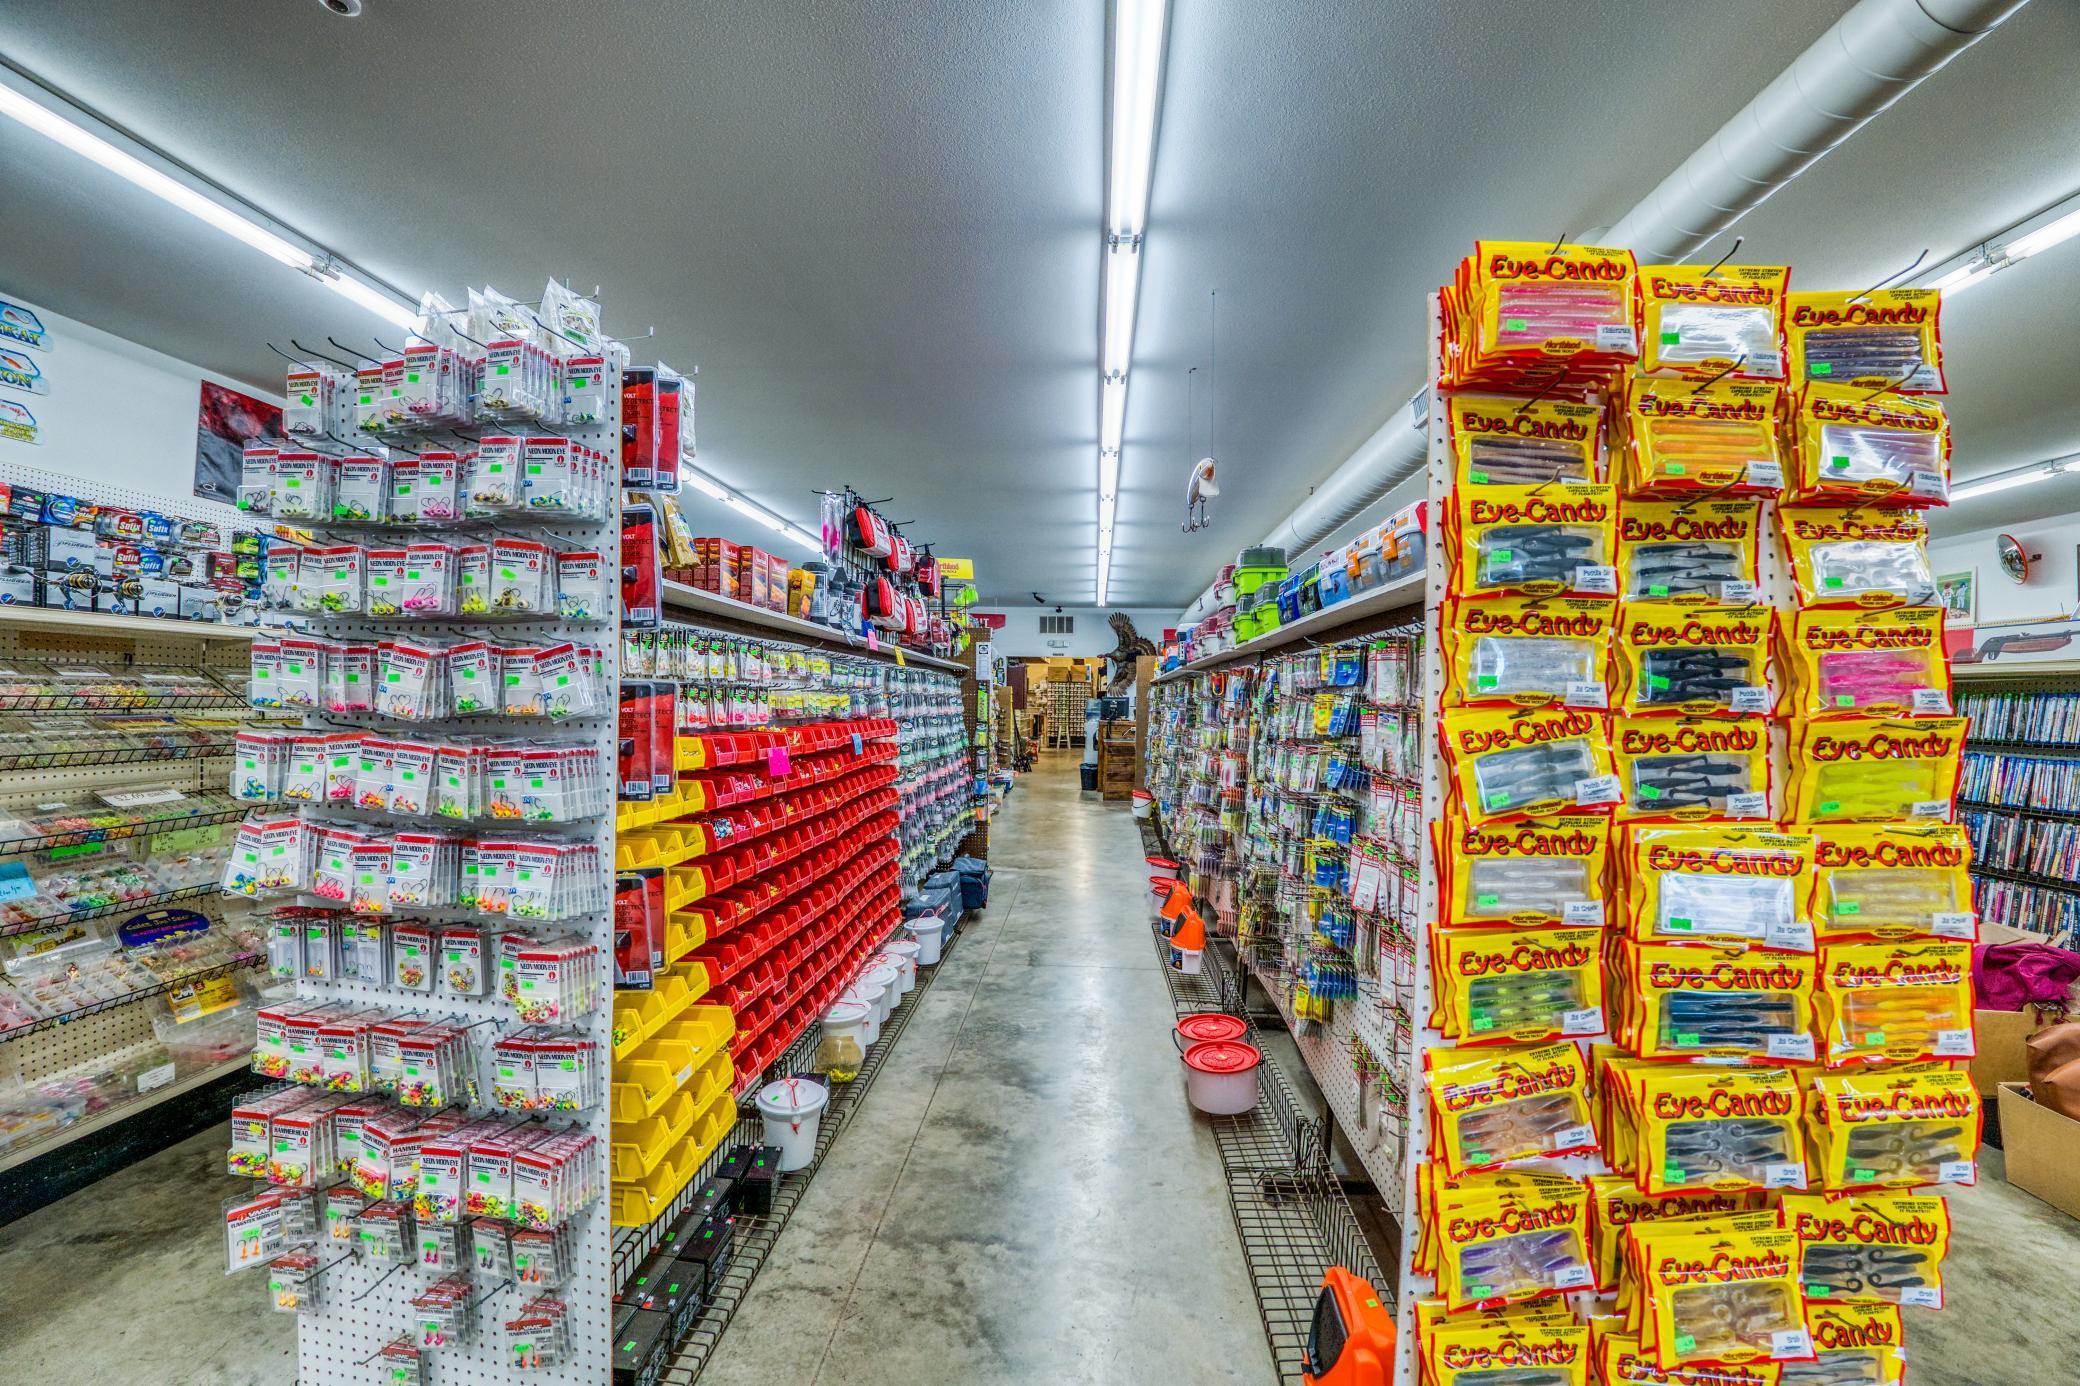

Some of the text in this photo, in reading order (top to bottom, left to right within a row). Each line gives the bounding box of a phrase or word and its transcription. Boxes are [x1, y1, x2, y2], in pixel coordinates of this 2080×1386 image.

[1490, 254, 1626, 280] Eye-Candy
[1651, 277, 1774, 304] Eye-Candy
[1792, 302, 1927, 327] Eye-Candy
[1638, 394, 1765, 420] Eye-Candy
[1812, 397, 1939, 430] Eye-Candy
[1463, 411, 1588, 441] Eye-Candy
[1470, 497, 1606, 524] Eye-Candy
[120, 523, 141, 531] Sufix
[149, 524, 168, 533] Sufix
[1621, 515, 1747, 541] Eye-Candy
[1793, 520, 1919, 541] Eye-Candy
[117, 553, 139, 562] Sufix
[1465, 609, 1603, 636] Eye-Candy
[1630, 621, 1760, 645] Eye-Candy
[1805, 623, 1932, 649] Eye-Candy
[1458, 710, 1594, 754] Eye-Candy
[1622, 725, 1758, 753] Eye-Candy
[1812, 731, 1952, 761] Eye-Candy
[1462, 829, 1597, 856] Eye-Candy
[1816, 840, 1961, 867] Eye-Candy
[1649, 845, 1803, 877] Eye-Candy
[1459, 942, 1590, 975] Eye-Candy
[1650, 962, 1803, 989] Eye-Candy
[1833, 958, 1961, 987] Eye-Candy
[1443, 1062, 1575, 1111] Eye-Candy
[1654, 1086, 1792, 1119] Eye-Candy
[1836, 1088, 1972, 1122] Eye-Candy
[1449, 1201, 1577, 1243] Eye-Candy
[1797, 1213, 1937, 1245] Eye-Candy
[1659, 1250, 1789, 1286] Eye-Candy
[1444, 1338, 1578, 1369] Eye-Candy
